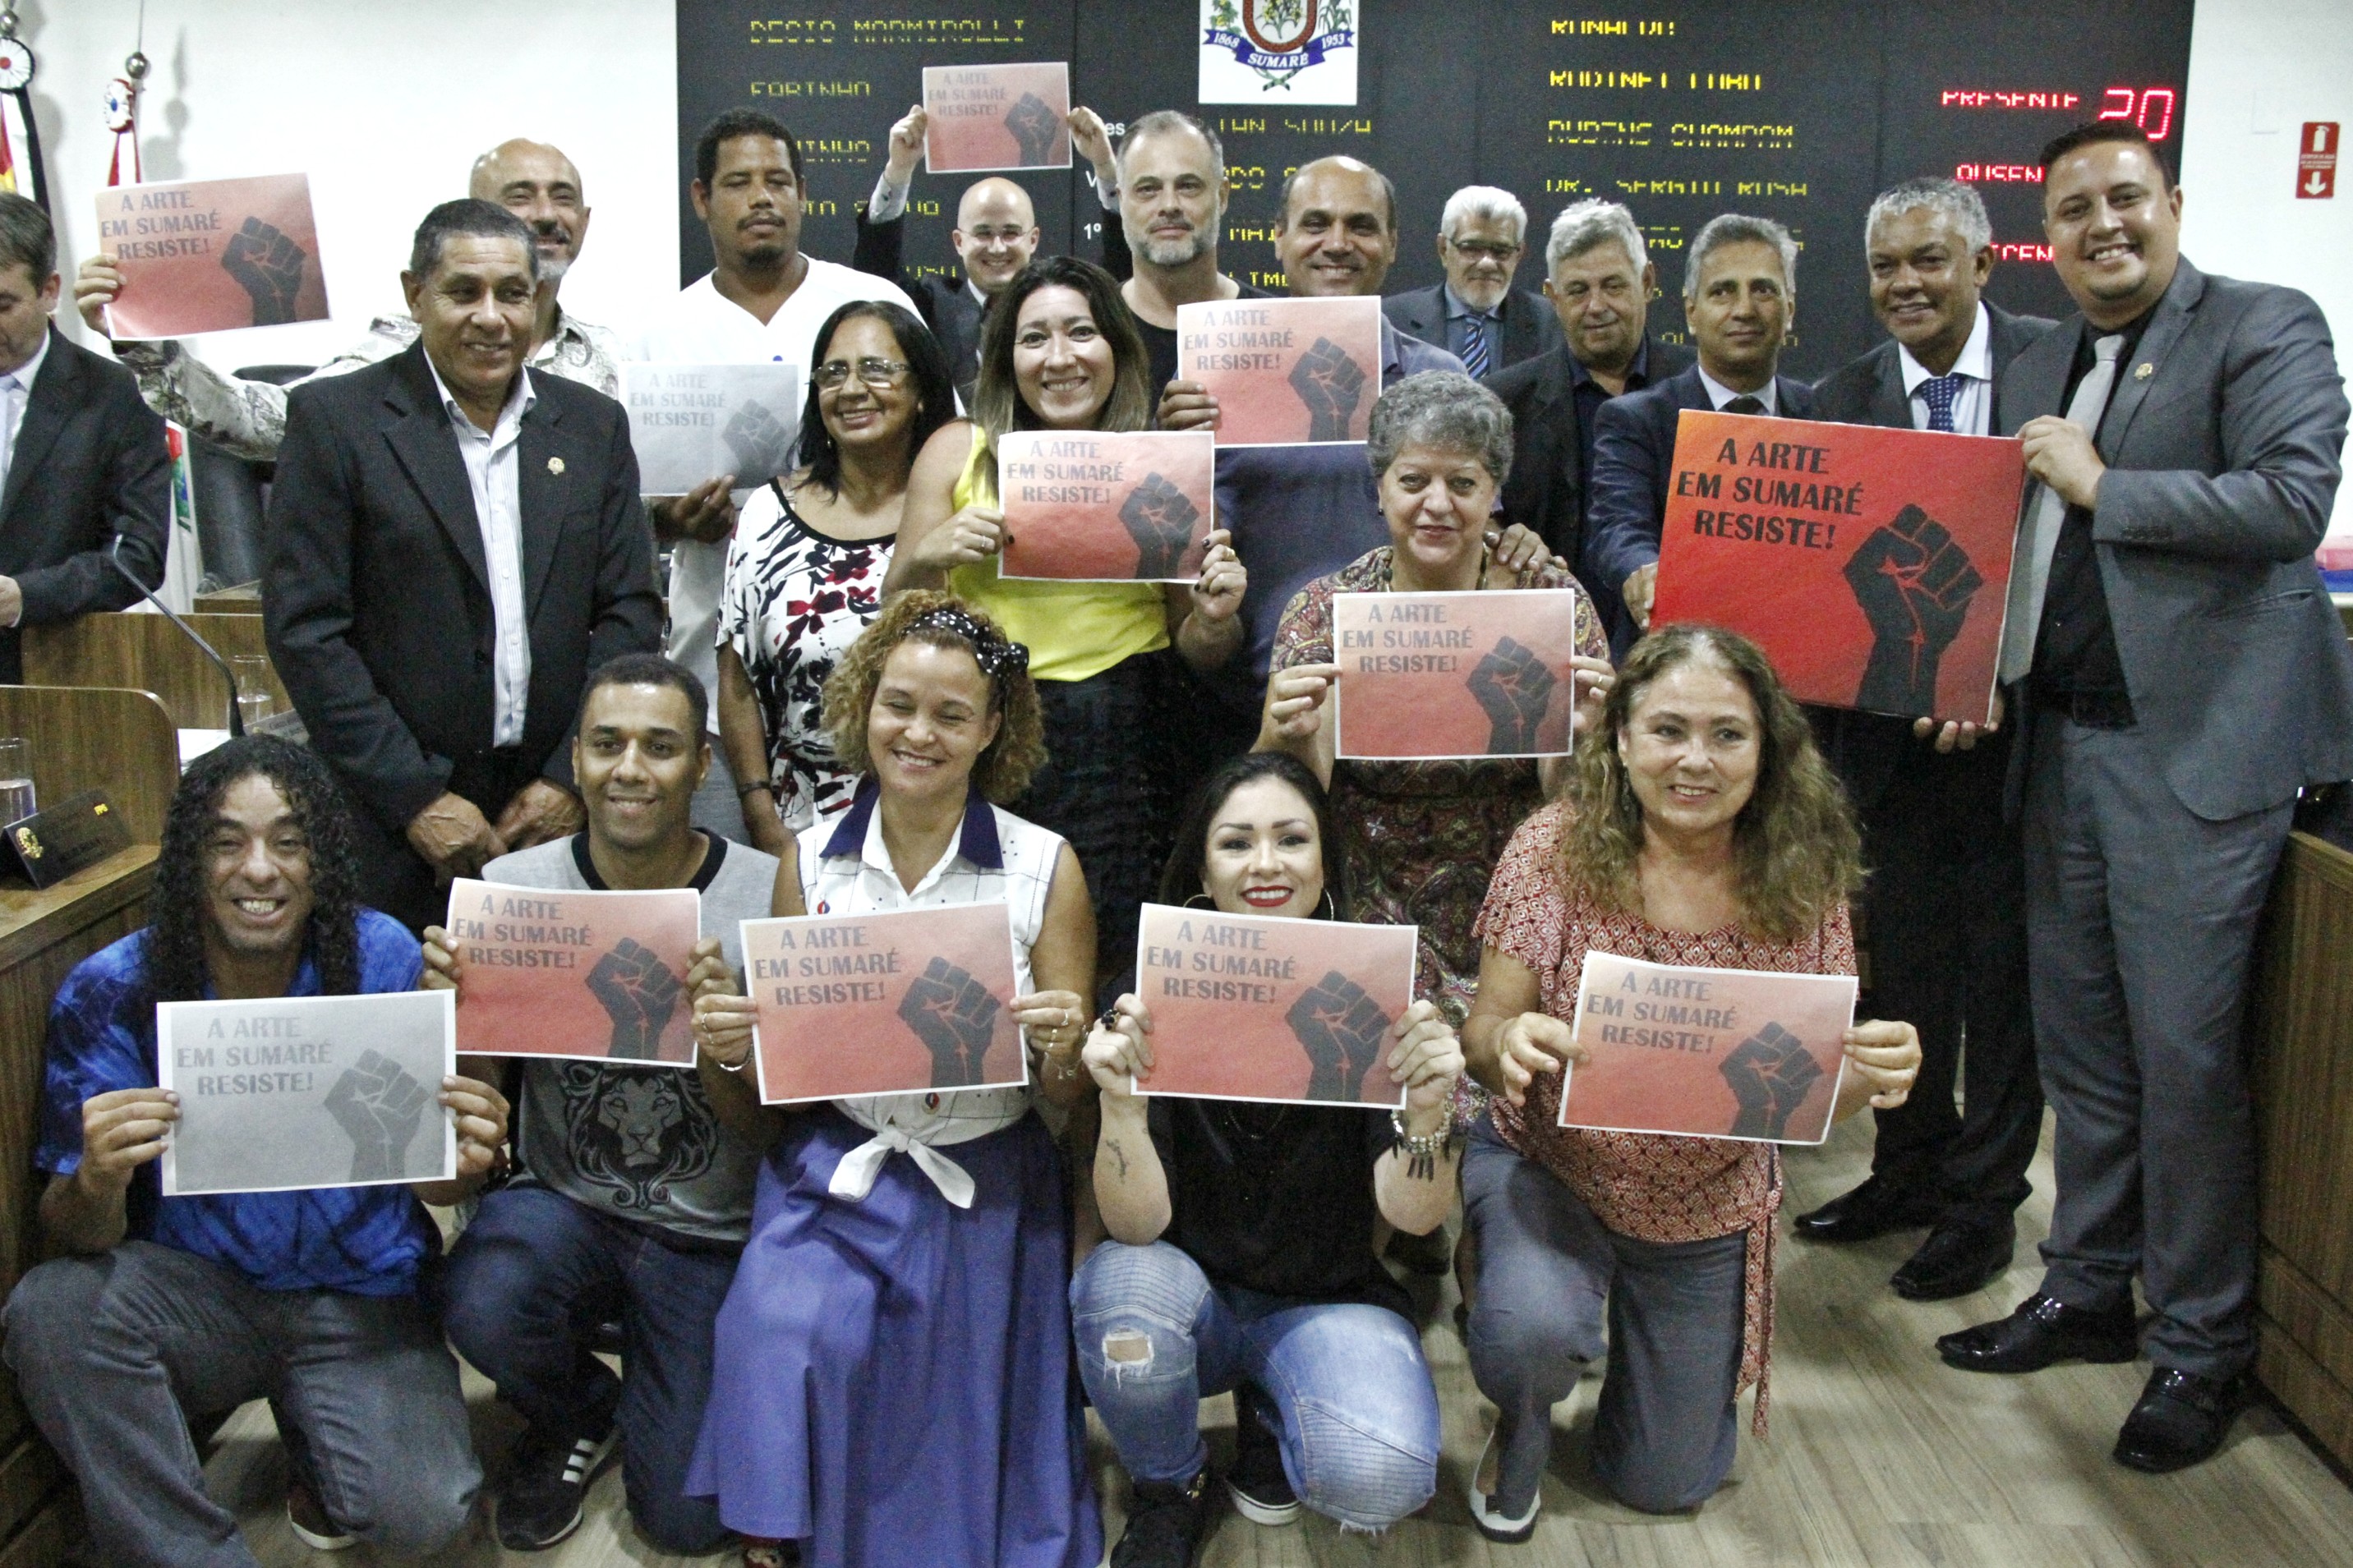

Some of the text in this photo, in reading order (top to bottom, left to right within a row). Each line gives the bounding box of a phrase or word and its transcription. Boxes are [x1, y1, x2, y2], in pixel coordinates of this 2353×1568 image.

[1213, 31, 1241, 48] 1868
[1321, 33, 1345, 48] 1953
[1247, 53, 1310, 67] SUMARÉ
[122, 191, 194, 211] A ARTE
[101, 209, 222, 237] EM SUMARÉ
[117, 238, 209, 260] RESISTE!
[1204, 310, 1272, 327] A ARTE
[1185, 329, 1293, 350] EM SUMARÉ
[1197, 354, 1280, 370] RESISTE!
[649, 373, 707, 389] A ARTE
[630, 393, 655, 407] EM
[1030, 441, 1101, 458] A ARTE
[1717, 438, 1830, 474] A ARTE
[1007, 462, 1124, 481] EM SUMARÉ
[1022, 486, 1110, 504] RESISTE!
[1677, 471, 1863, 516] EM SUMARÉ
[1694, 510, 1836, 549] RESISTE!
[1368, 604, 1447, 623] A ARTE
[1342, 626, 1473, 649] EM SUMARÉ
[1360, 655, 1457, 673] RESISTE!
[481, 894, 564, 921] A ARTE
[454, 918, 592, 946] EM SUMARÉ
[780, 927, 869, 950] A ARTE
[1177, 921, 1268, 951] A ARTE
[469, 948, 575, 968] RESISTE!
[755, 947, 901, 979] EM SUMARÉ
[1147, 946, 1296, 980] EM SUMARÉ
[776, 982, 886, 1006] RESISTE!
[1163, 977, 1277, 1004] RESISTE!
[1621, 971, 1713, 1001] A ARTE
[1586, 994, 1737, 1030] EM SUMARÉ
[207, 1017, 302, 1038] A ARTE
[1601, 1024, 1715, 1054] RESISTE!
[177, 1042, 333, 1068] EM SUMARÉ
[198, 1072, 313, 1096] RESISTE!
